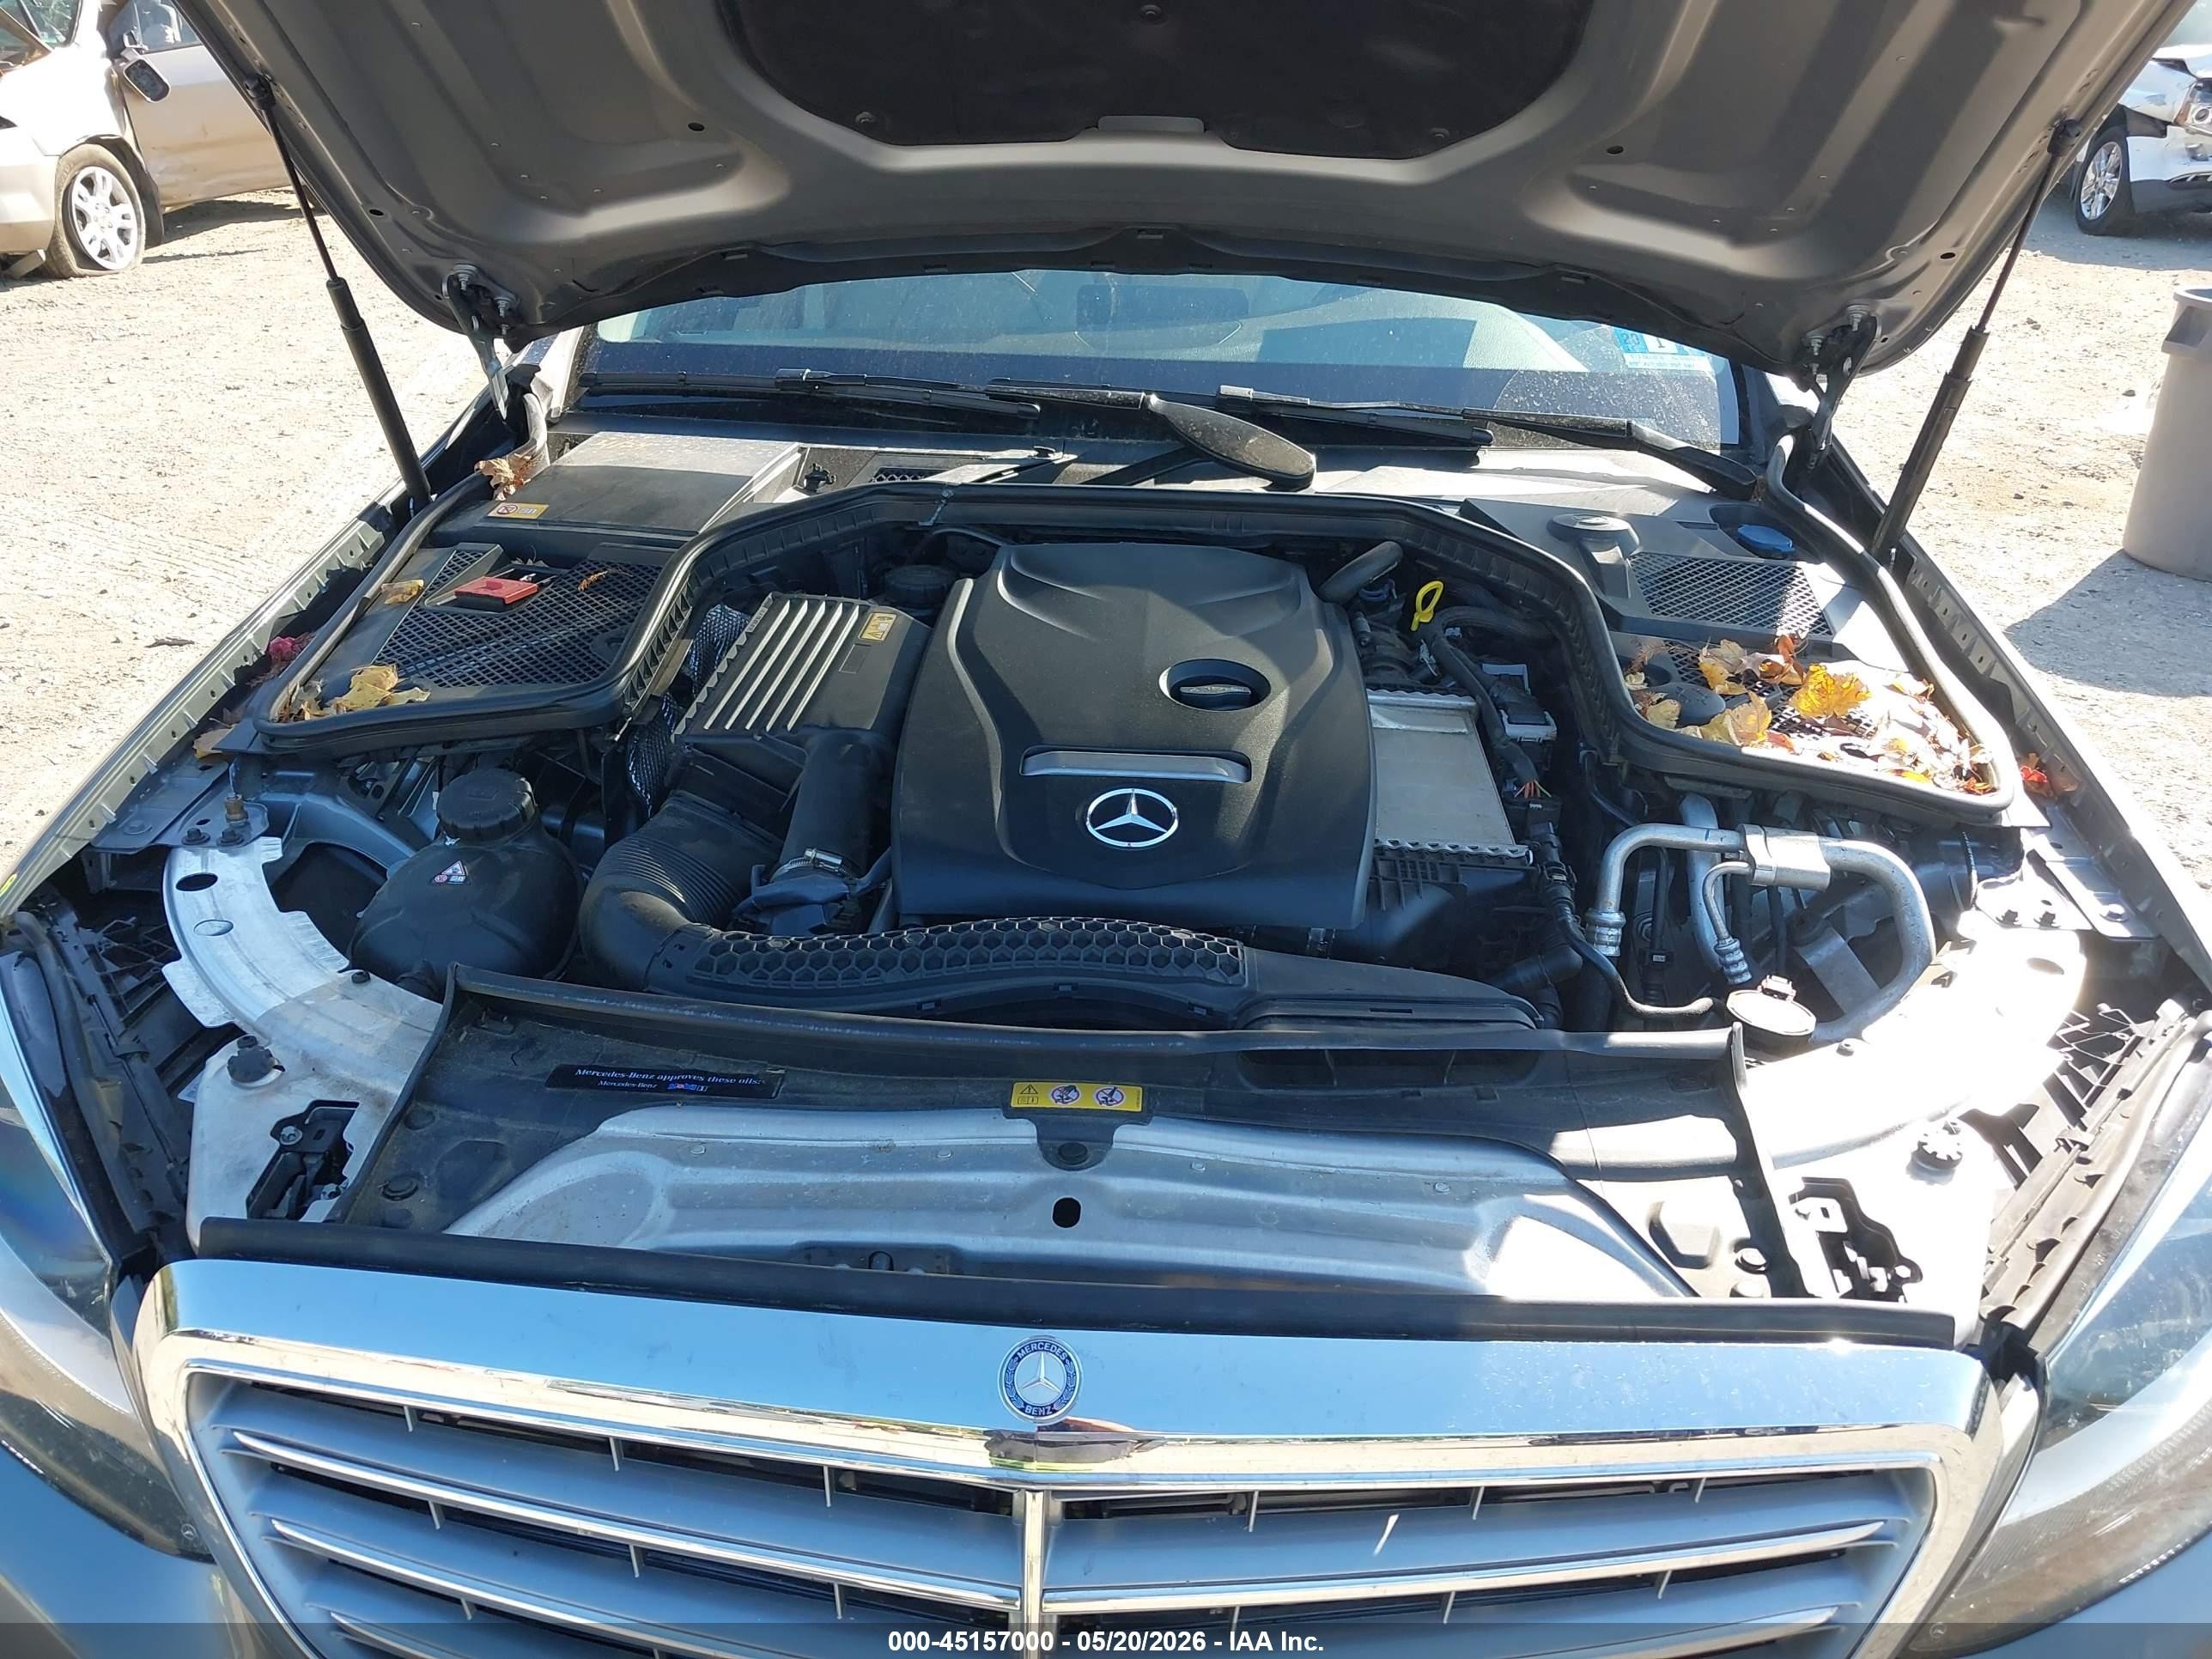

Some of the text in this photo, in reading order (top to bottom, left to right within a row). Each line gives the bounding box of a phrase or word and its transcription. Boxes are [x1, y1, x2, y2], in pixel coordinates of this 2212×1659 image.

[574, 1067, 655, 1079] Mercedes-Benz
[657, 1073, 705, 1082] approves
[707, 1075, 737, 1084] these
[597, 1079, 658, 1089] Mercedes-Benz
[1017, 1341, 1068, 1361] MERCEDES
[1024, 1406, 1053, 1416] BENZ
